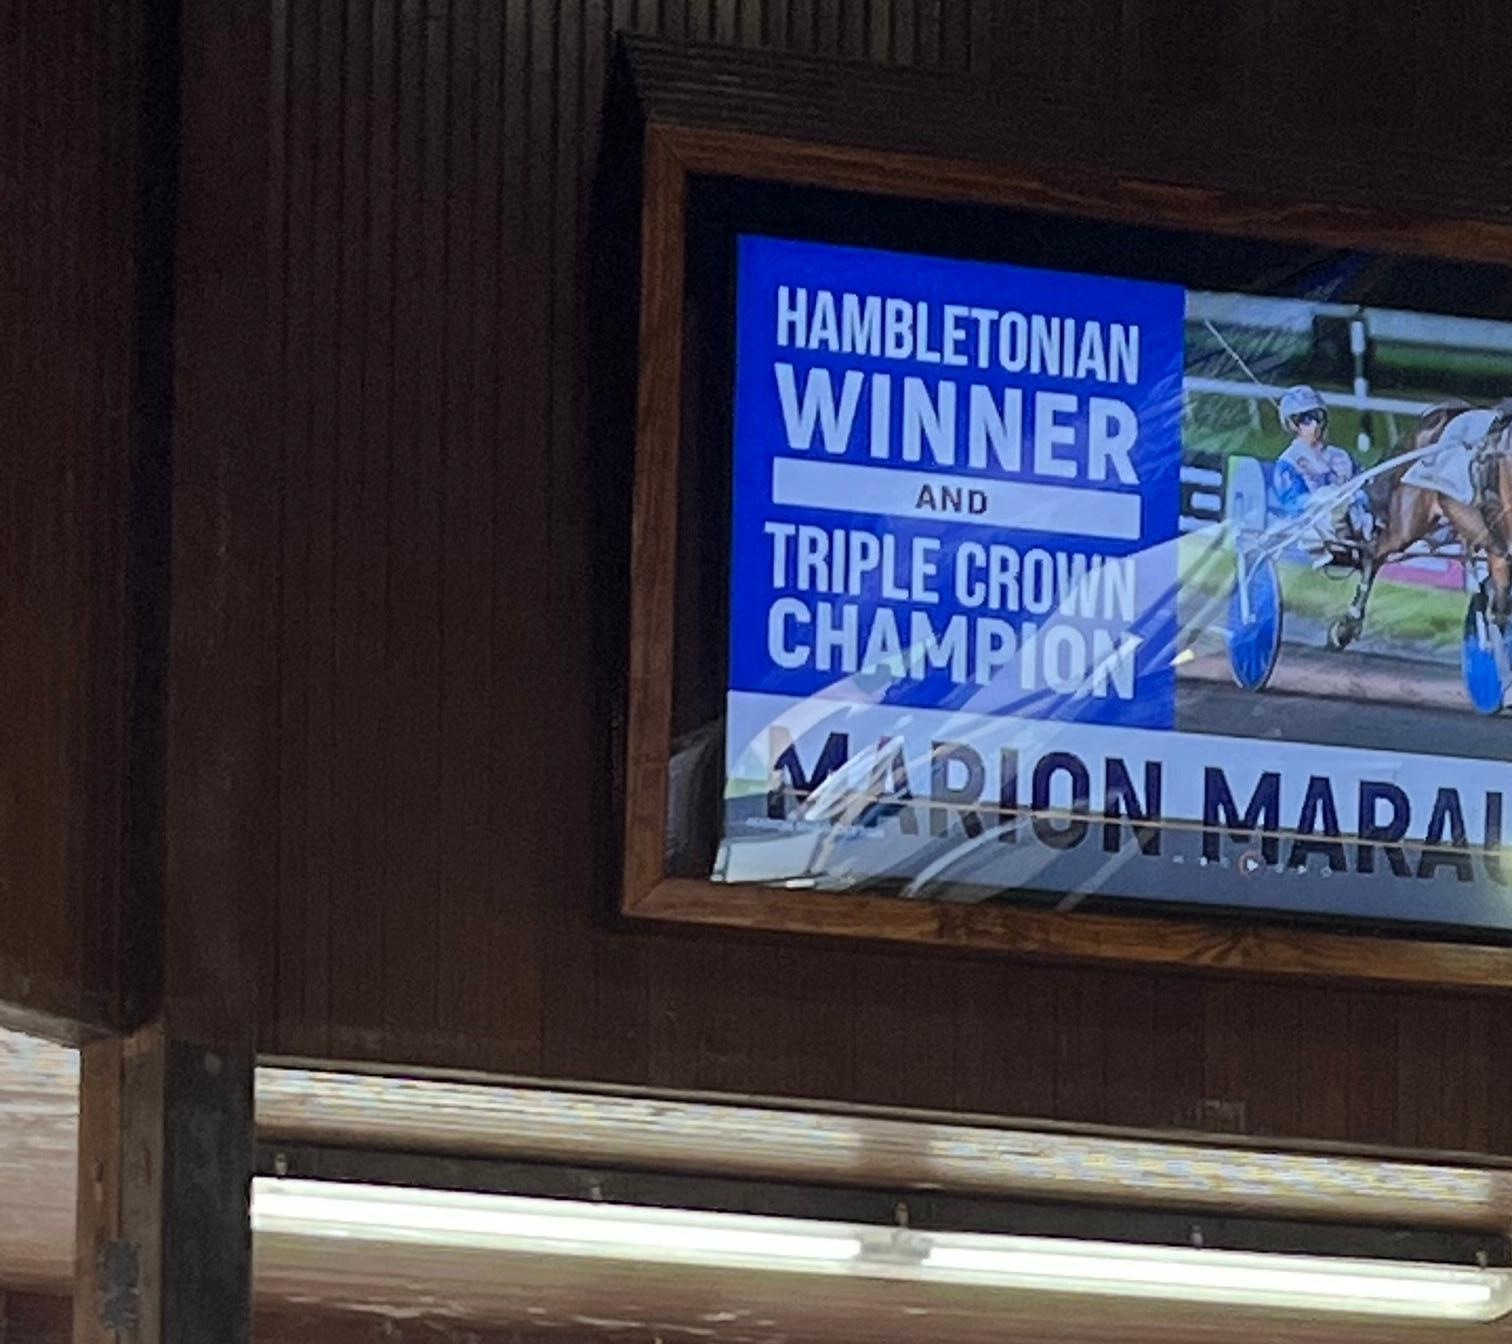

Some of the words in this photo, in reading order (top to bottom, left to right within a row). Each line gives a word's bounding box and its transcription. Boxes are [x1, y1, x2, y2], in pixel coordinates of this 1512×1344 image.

[777, 286, 1139, 384] HAMBLETONIAN
[774, 362, 1139, 485] WINNER
[915, 484, 988, 515] AND
[764, 521, 940, 604] TRIPLE
[955, 541, 1137, 621] CROWN
[767, 597, 1138, 699] CHAMPION
[767, 725, 1162, 856] MARION
